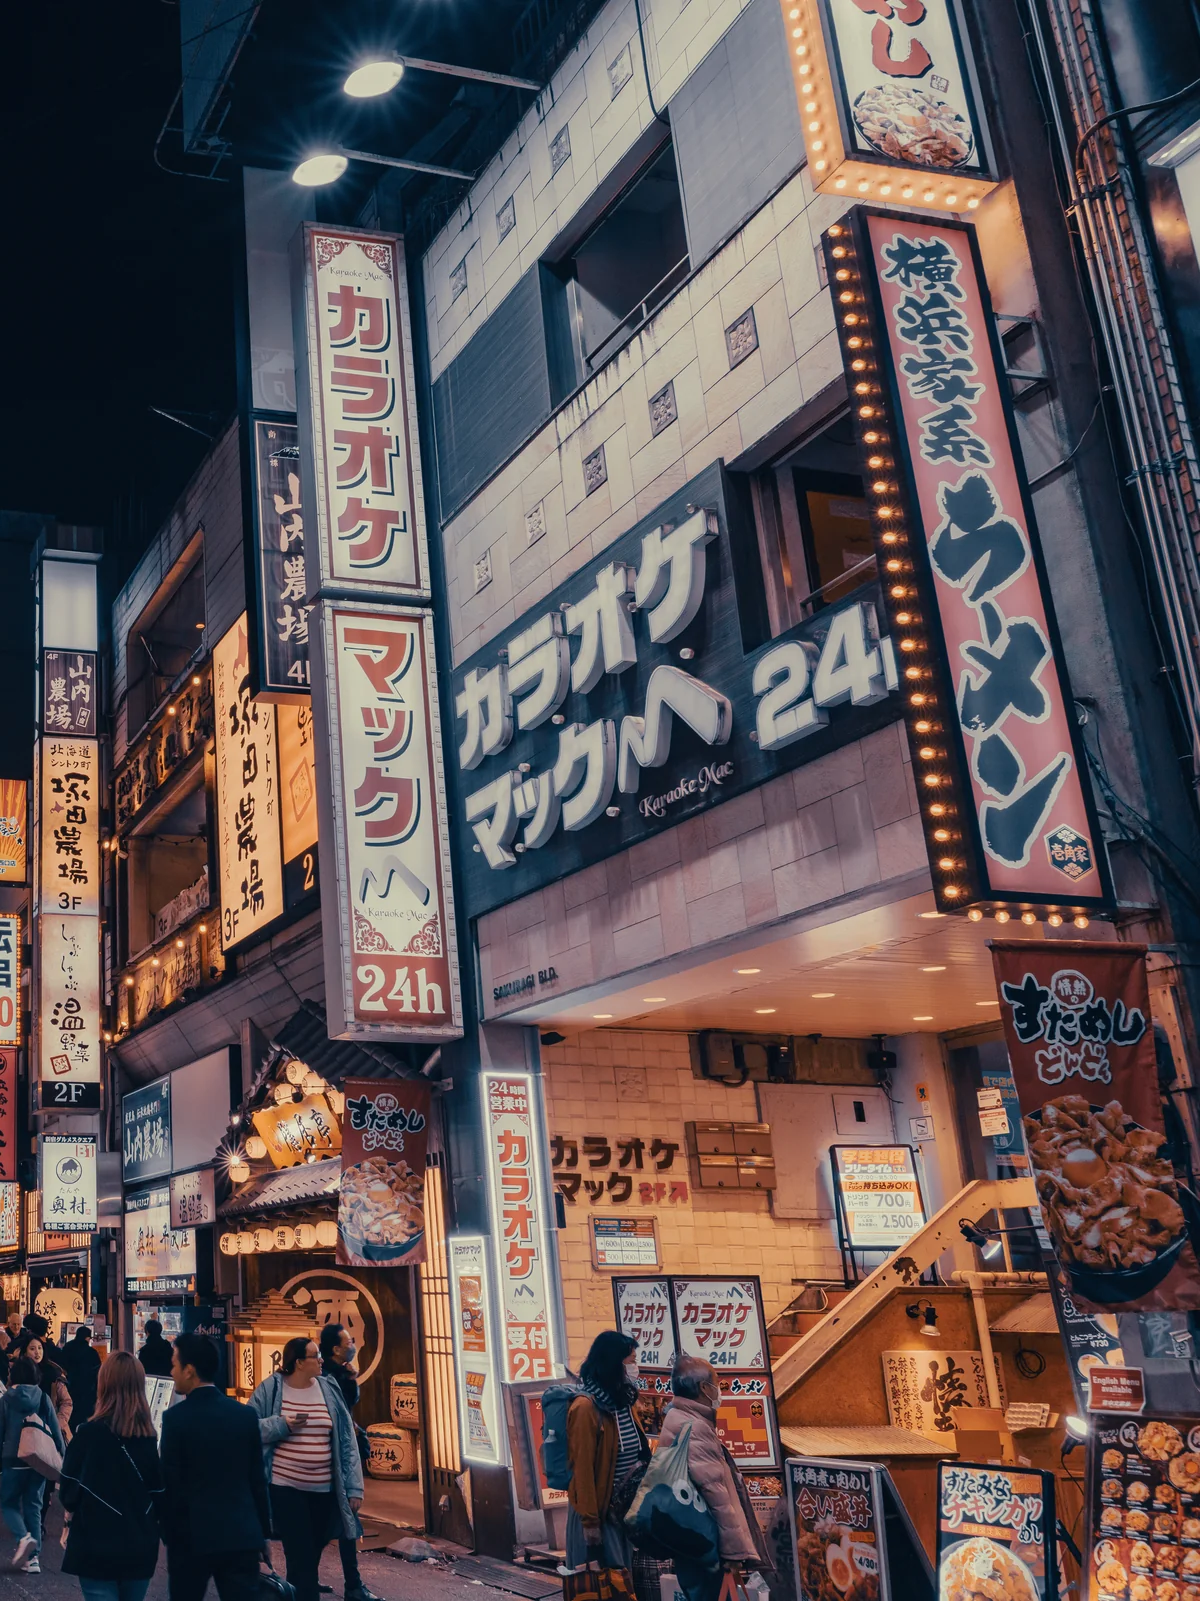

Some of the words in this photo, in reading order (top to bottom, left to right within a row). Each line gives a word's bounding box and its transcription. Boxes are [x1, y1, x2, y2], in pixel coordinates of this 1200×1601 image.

[327, 284, 406, 568] カラオケ
[455, 508, 712, 770] カラオケ
[50, 744, 91, 758] 北海道
[639, 780, 697, 818] Karaoke
[698, 761, 734, 793] Mac
[50, 772, 91, 885] 塚田農場
[58, 892, 82, 910] 3F
[224, 907, 239, 943] 3F
[357, 964, 445, 1014] 24h
[493, 974, 535, 1000] SAKURAGI
[1001, 973, 1146, 1046] すためし
[54, 1082, 86, 1103] 2F
[489, 1080, 526, 1096] 24時間
[347, 1095, 425, 1132] すためし
[490, 1096, 527, 1112] 営業中
[124, 1116, 164, 1167] 山内農場
[550, 1135, 680, 1171] カラオケ
[552, 1171, 634, 1203] マック
[50, 1196, 87, 1215] 奥村
[497, 1129, 538, 1280] カラオケ
[623, 1302, 668, 1325] カラオケ
[681, 1302, 753, 1325] カラオケ
[194, 1323, 221, 1335] Asahi
[507, 1326, 548, 1351] 受付
[693, 1327, 747, 1349] マック
[513, 1353, 546, 1380] 2F
[640, 1350, 659, 1364] 24H
[708, 1350, 738, 1365] 24H
[731, 1378, 767, 1394] ラーメン
[1092, 1375, 1118, 1386] English
[1120, 1376, 1141, 1386] Menu
[1101, 1385, 1133, 1394] available
[944, 1470, 1010, 1499] すたみな
[942, 1494, 1043, 1529] チキンカツ
[1018, 1524, 1043, 1544] めし
